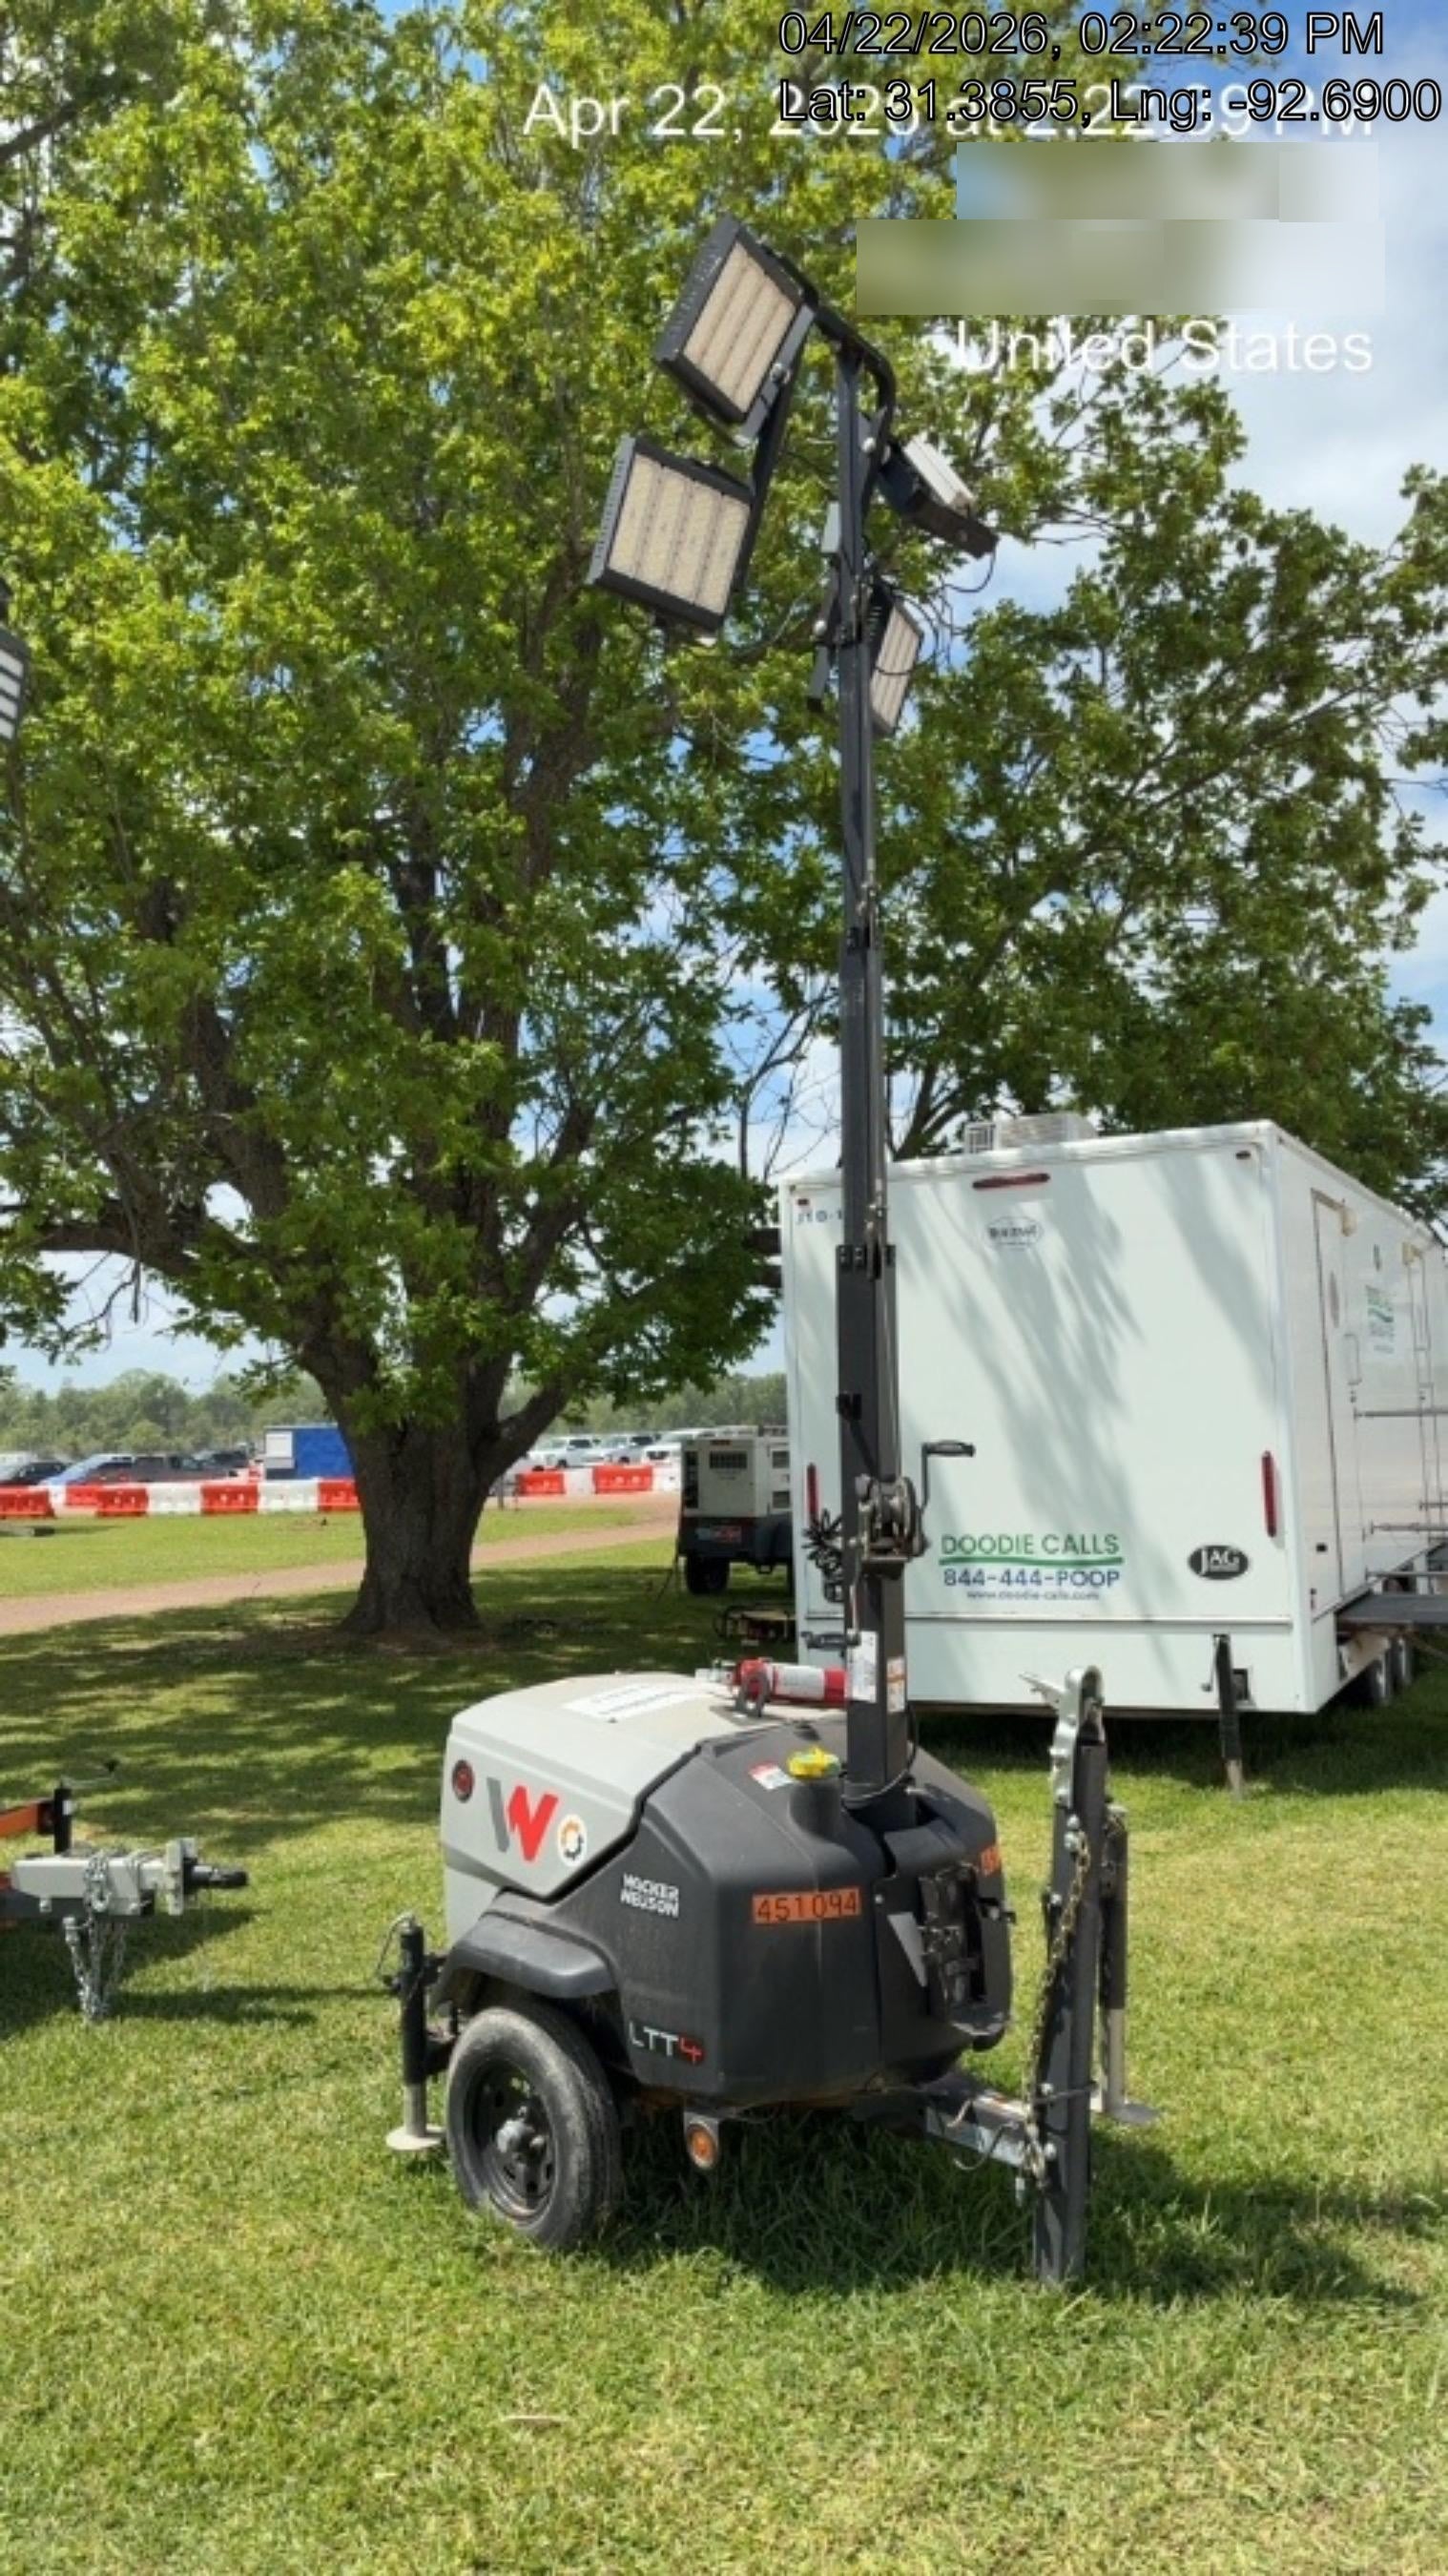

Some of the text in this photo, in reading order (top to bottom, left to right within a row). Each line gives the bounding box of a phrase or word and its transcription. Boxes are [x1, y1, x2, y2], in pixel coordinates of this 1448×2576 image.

[941, 1533, 1121, 1555] DOODIE CALLS
[942, 1568, 1121, 1588] 844-444-POOP
[756, 1891, 858, 1922] 451094
[628, 2021, 703, 2064] LTT4
